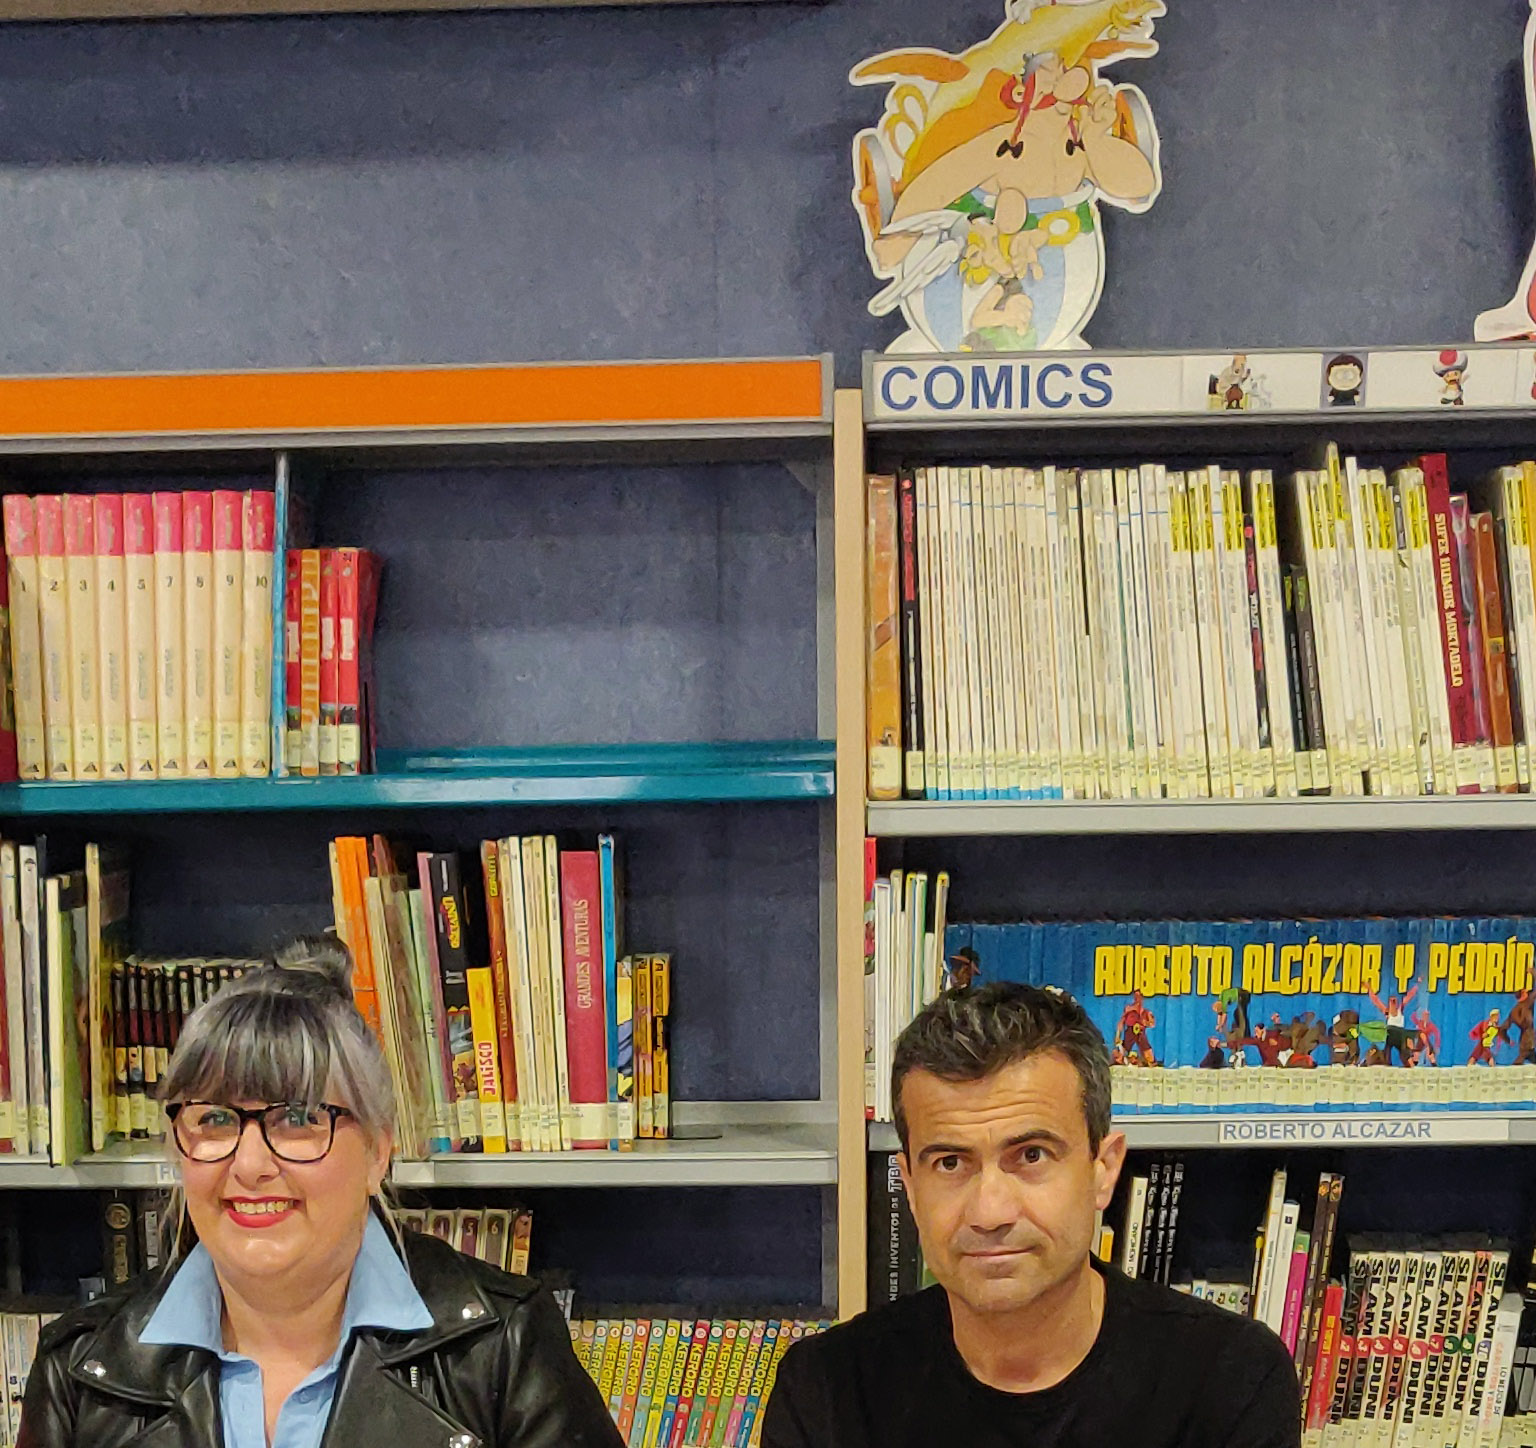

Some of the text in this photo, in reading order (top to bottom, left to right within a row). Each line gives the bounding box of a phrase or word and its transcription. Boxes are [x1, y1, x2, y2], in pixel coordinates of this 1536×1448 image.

[879, 361, 1115, 411] COMICS
[1438, 557, 1456, 609] HUMOR
[1444, 611, 1463, 688] MORTADELO
[576, 962, 592, 1009] GRANDES
[1093, 935, 1536, 998] ROBERTO ALCÁZAR Y PEDRÍN
[1222, 1121, 1433, 1141] ROBERTO ALCAZAR
[1361, 1258, 1384, 1336] SLAM
[1378, 1257, 1401, 1336] SLAM
[1397, 1257, 1418, 1336] SLAM
[1414, 1261, 1437, 1340] SLAM
[1432, 1255, 1456, 1335] SLAM
[1446, 1256, 1471, 1335] SLAM
[1465, 1255, 1490, 1335] SLAM
[1482, 1260, 1507, 1339] SLAM
[681, 1342, 704, 1398] KERORO
[750, 1343, 775, 1397] KERORO
